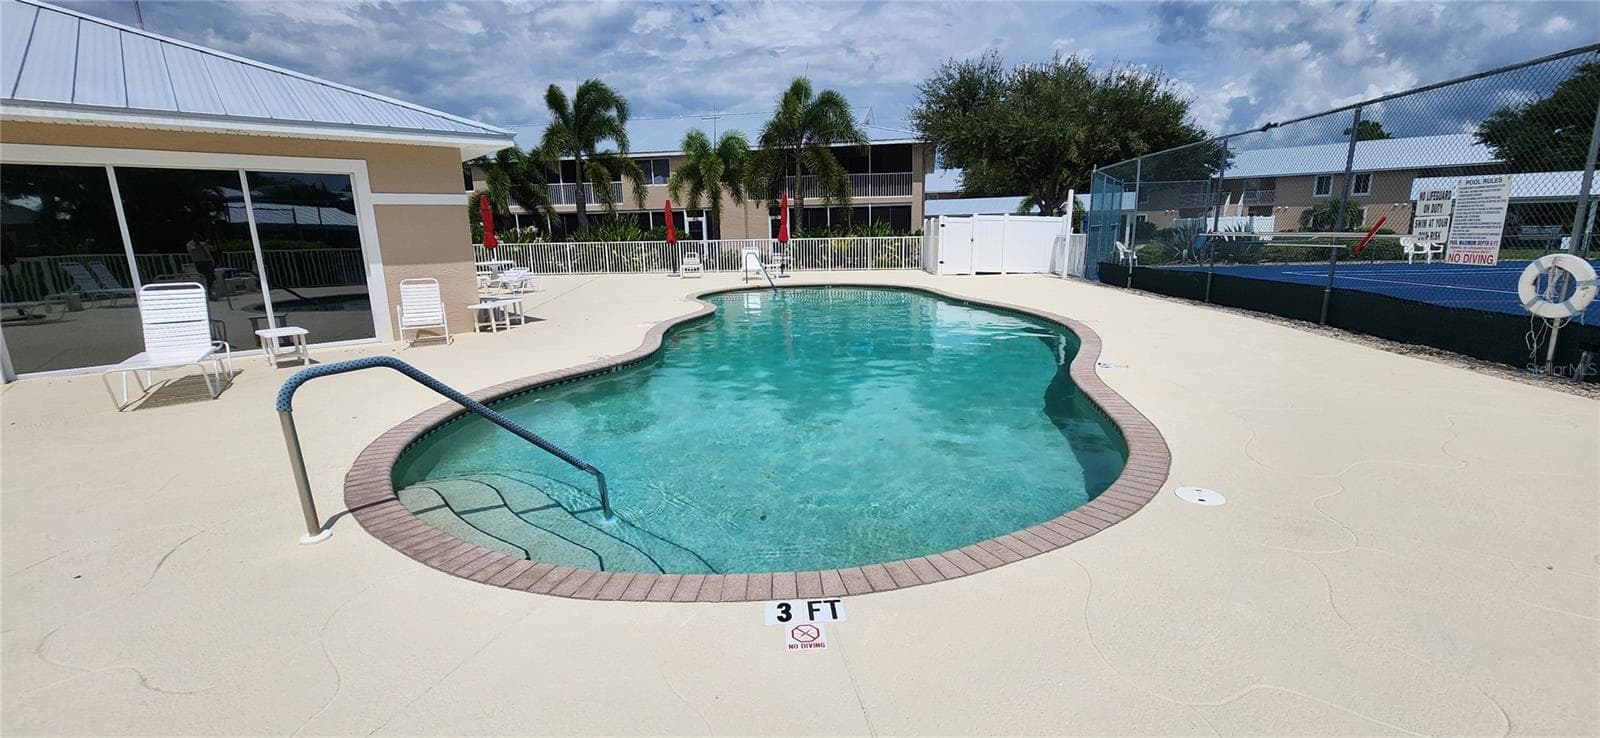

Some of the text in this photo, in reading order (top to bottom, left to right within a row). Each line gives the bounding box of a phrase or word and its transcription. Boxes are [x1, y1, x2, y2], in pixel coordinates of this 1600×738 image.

[1483, 177, 1503, 185] RULES
[1419, 190, 1452, 201] NO LIFEGUARD
[1423, 203, 1444, 213] ON DUTY
[1414, 218, 1449, 229] SWIM AT YOUR
[1430, 231, 1442, 240] RISK
[1447, 253, 1494, 265] NO DIVING
[776, 599, 841, 623] 3 FT
